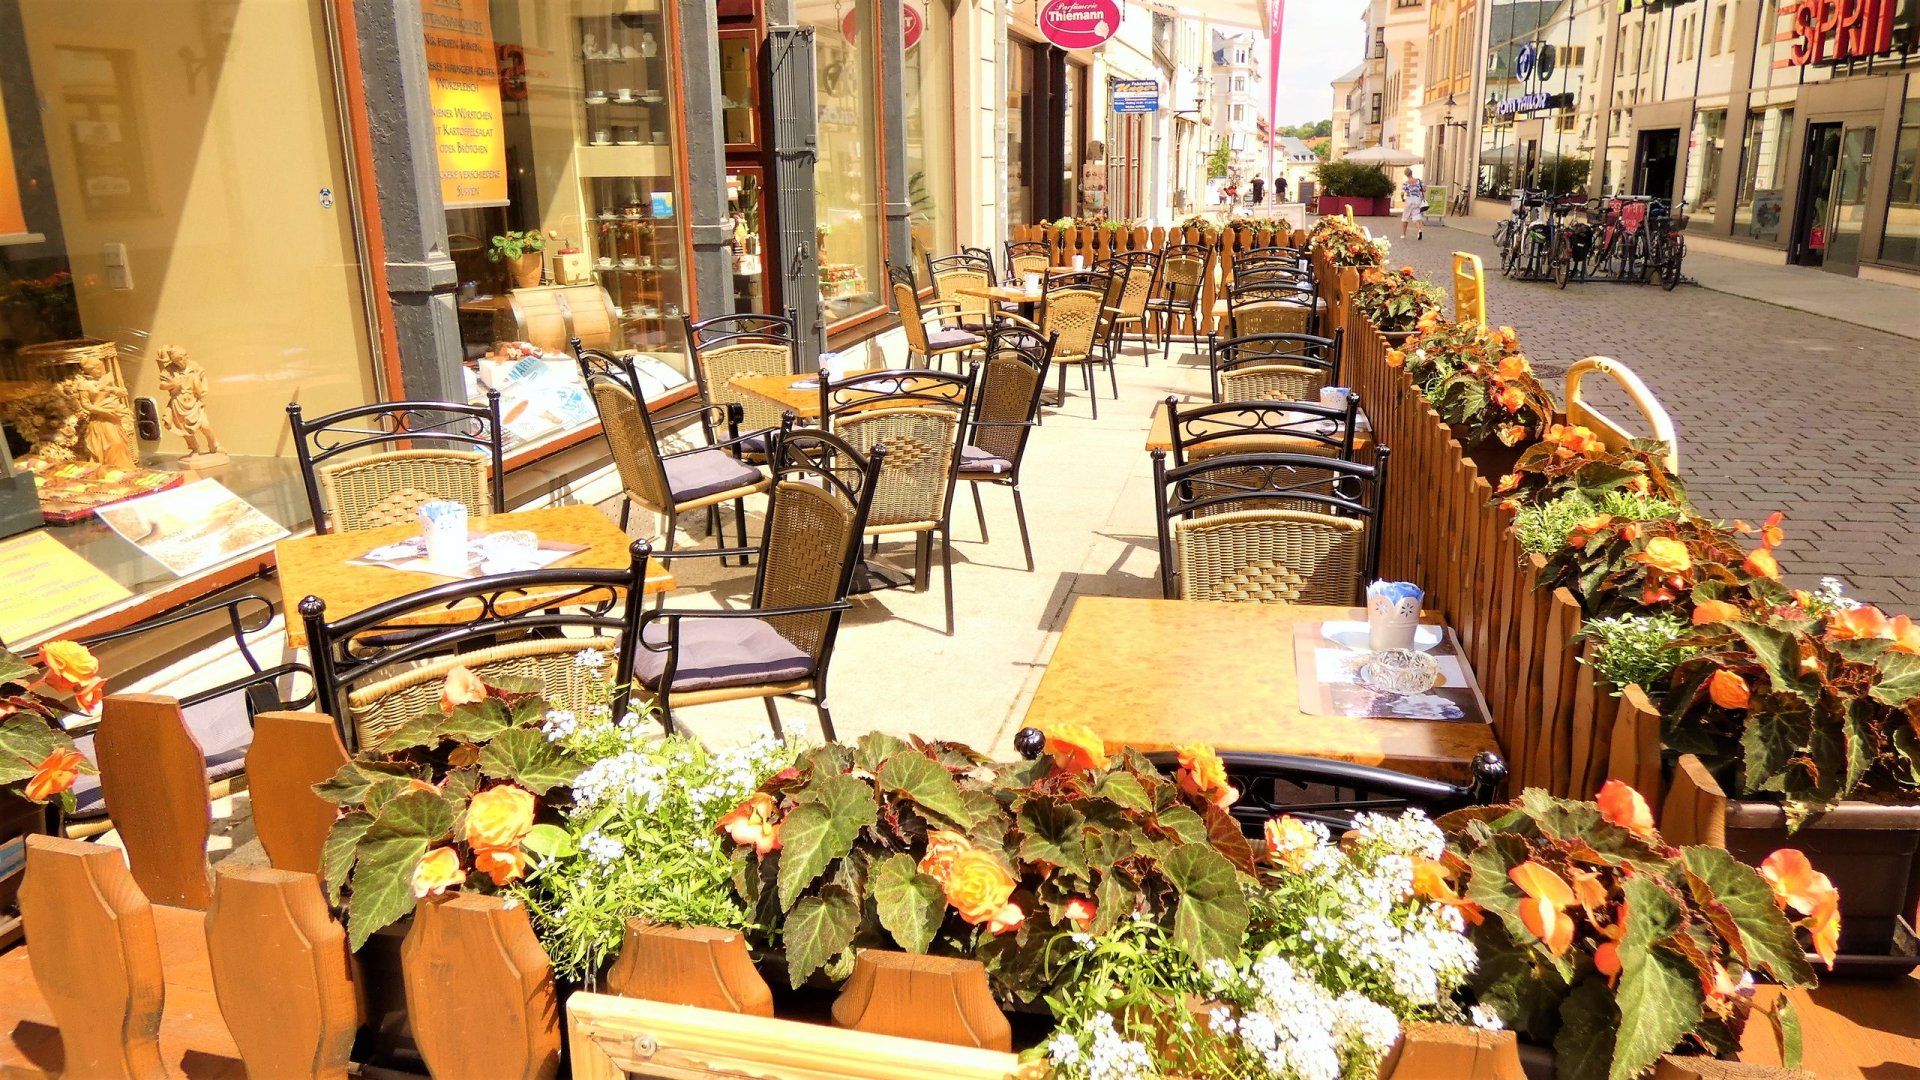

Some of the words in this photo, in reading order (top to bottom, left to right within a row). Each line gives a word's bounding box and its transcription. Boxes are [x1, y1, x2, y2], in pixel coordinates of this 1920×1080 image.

[1048, 11, 1104, 21] Thiemann
[1517, 93, 1547, 111] TAILOR
[454, 107, 494, 120] WÜRSTCHEN
[442, 124, 494, 137] KARTOFFELSALAT
